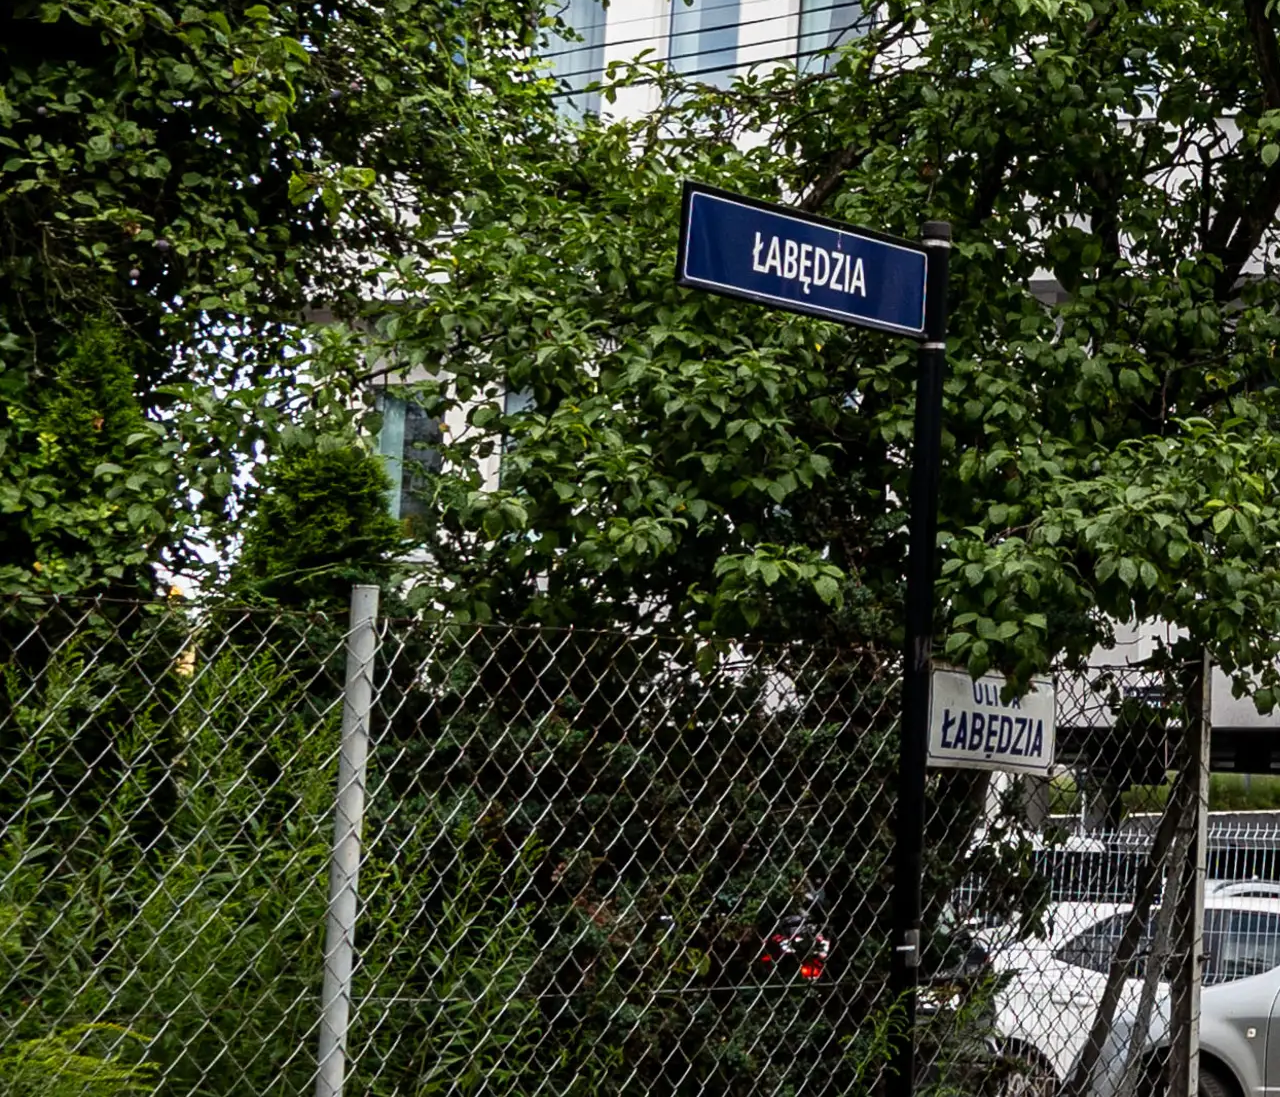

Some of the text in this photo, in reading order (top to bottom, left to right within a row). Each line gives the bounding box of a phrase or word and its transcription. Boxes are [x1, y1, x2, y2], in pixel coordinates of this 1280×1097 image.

[752, 231, 866, 298] ŁABĘDZIA
[973, 682, 1021, 710] ULIA
[941, 709, 1044, 759] ŁABĘDZIA
